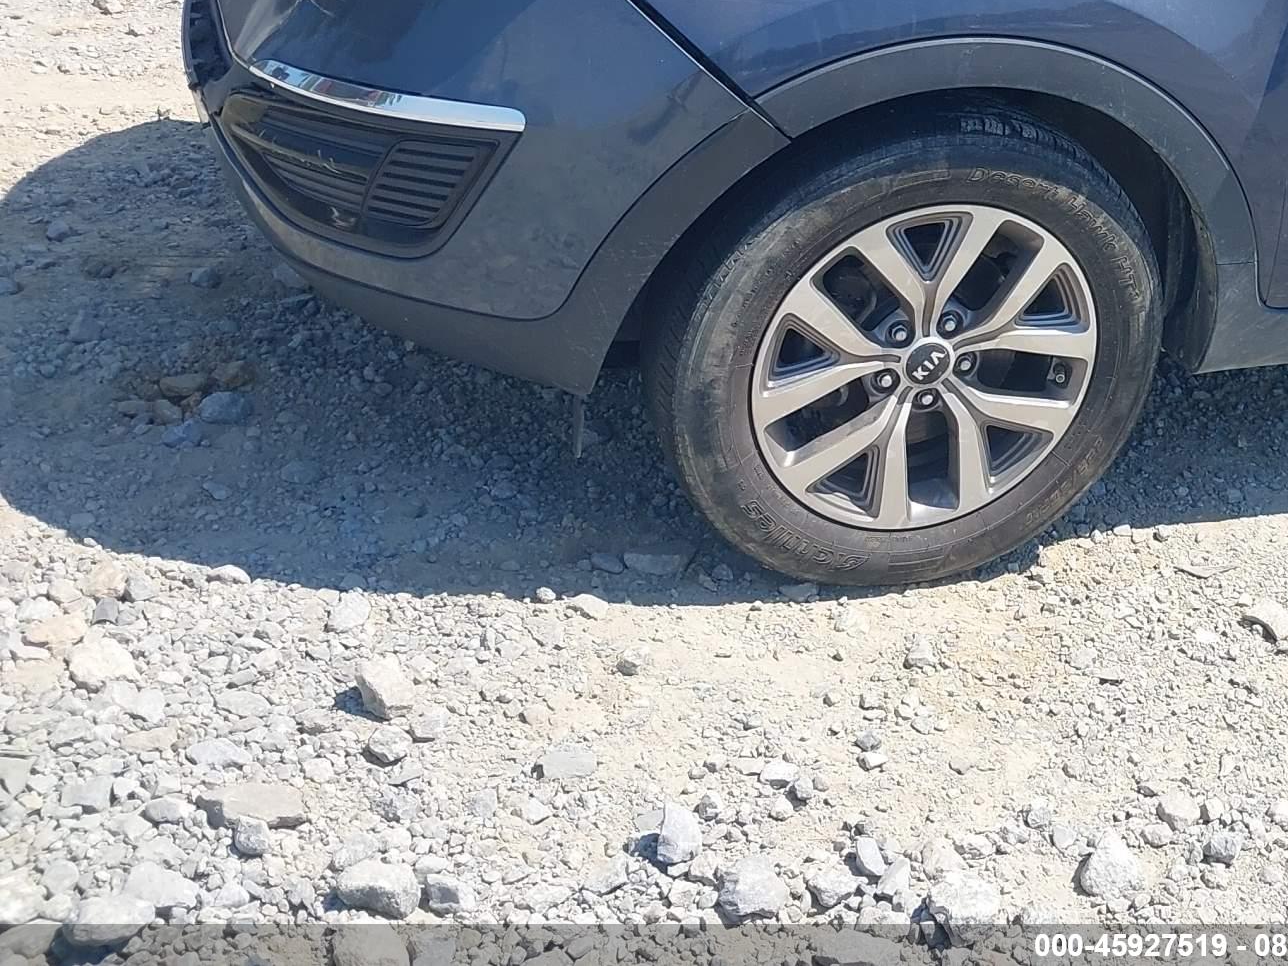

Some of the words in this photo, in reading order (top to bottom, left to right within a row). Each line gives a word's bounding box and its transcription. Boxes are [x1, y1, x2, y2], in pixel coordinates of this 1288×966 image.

[965, 166, 1061, 202] Desert
[1065, 196, 1118, 252] Hawk
[911, 351, 946, 381] KIA
